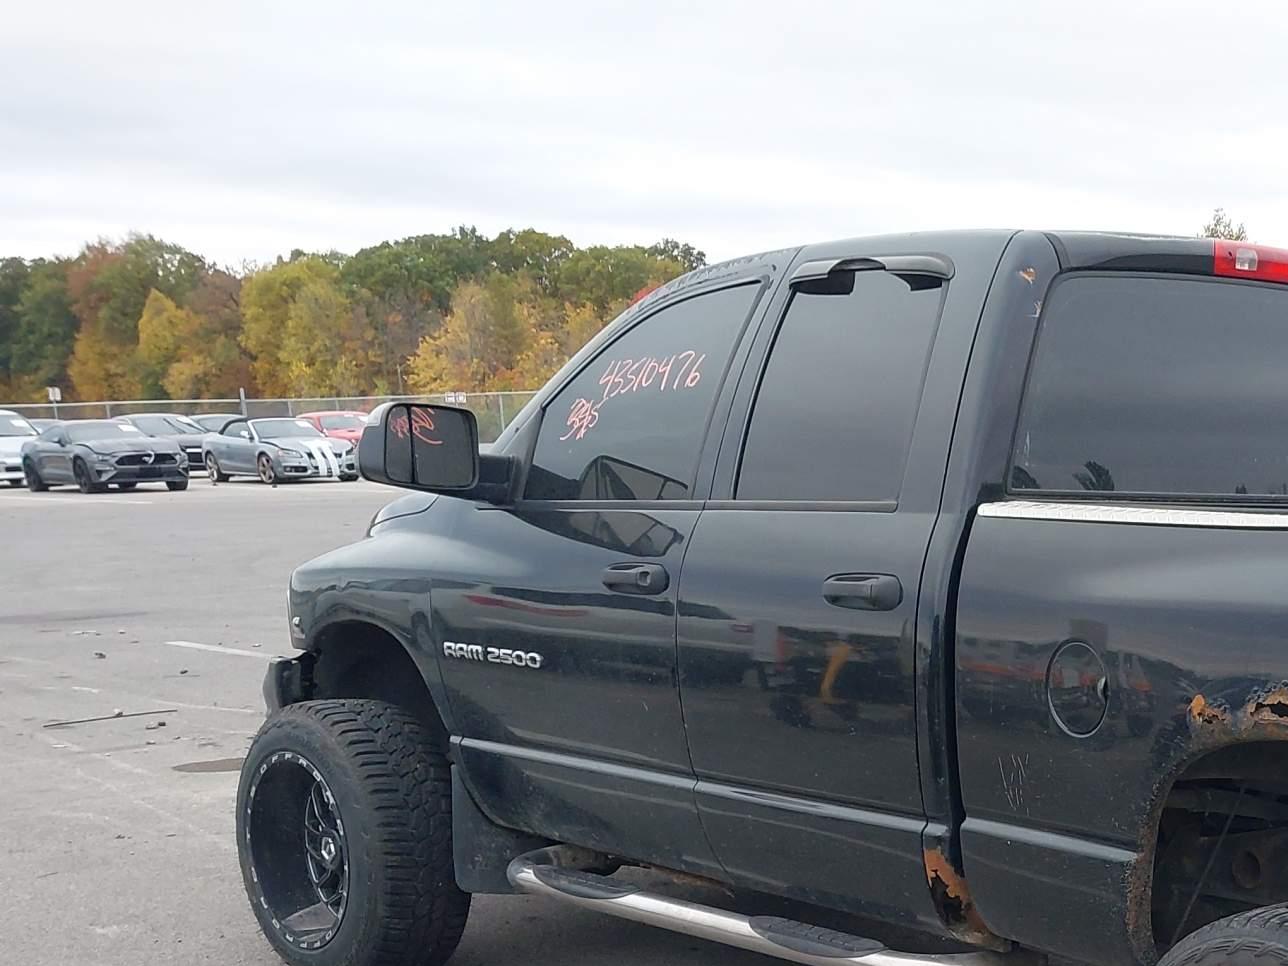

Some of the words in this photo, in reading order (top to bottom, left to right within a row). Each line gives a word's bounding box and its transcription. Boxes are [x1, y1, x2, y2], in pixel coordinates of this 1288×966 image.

[599, 350, 706, 398] 43510476
[443, 641, 484, 661] RAM
[486, 647, 541, 668] 2500
